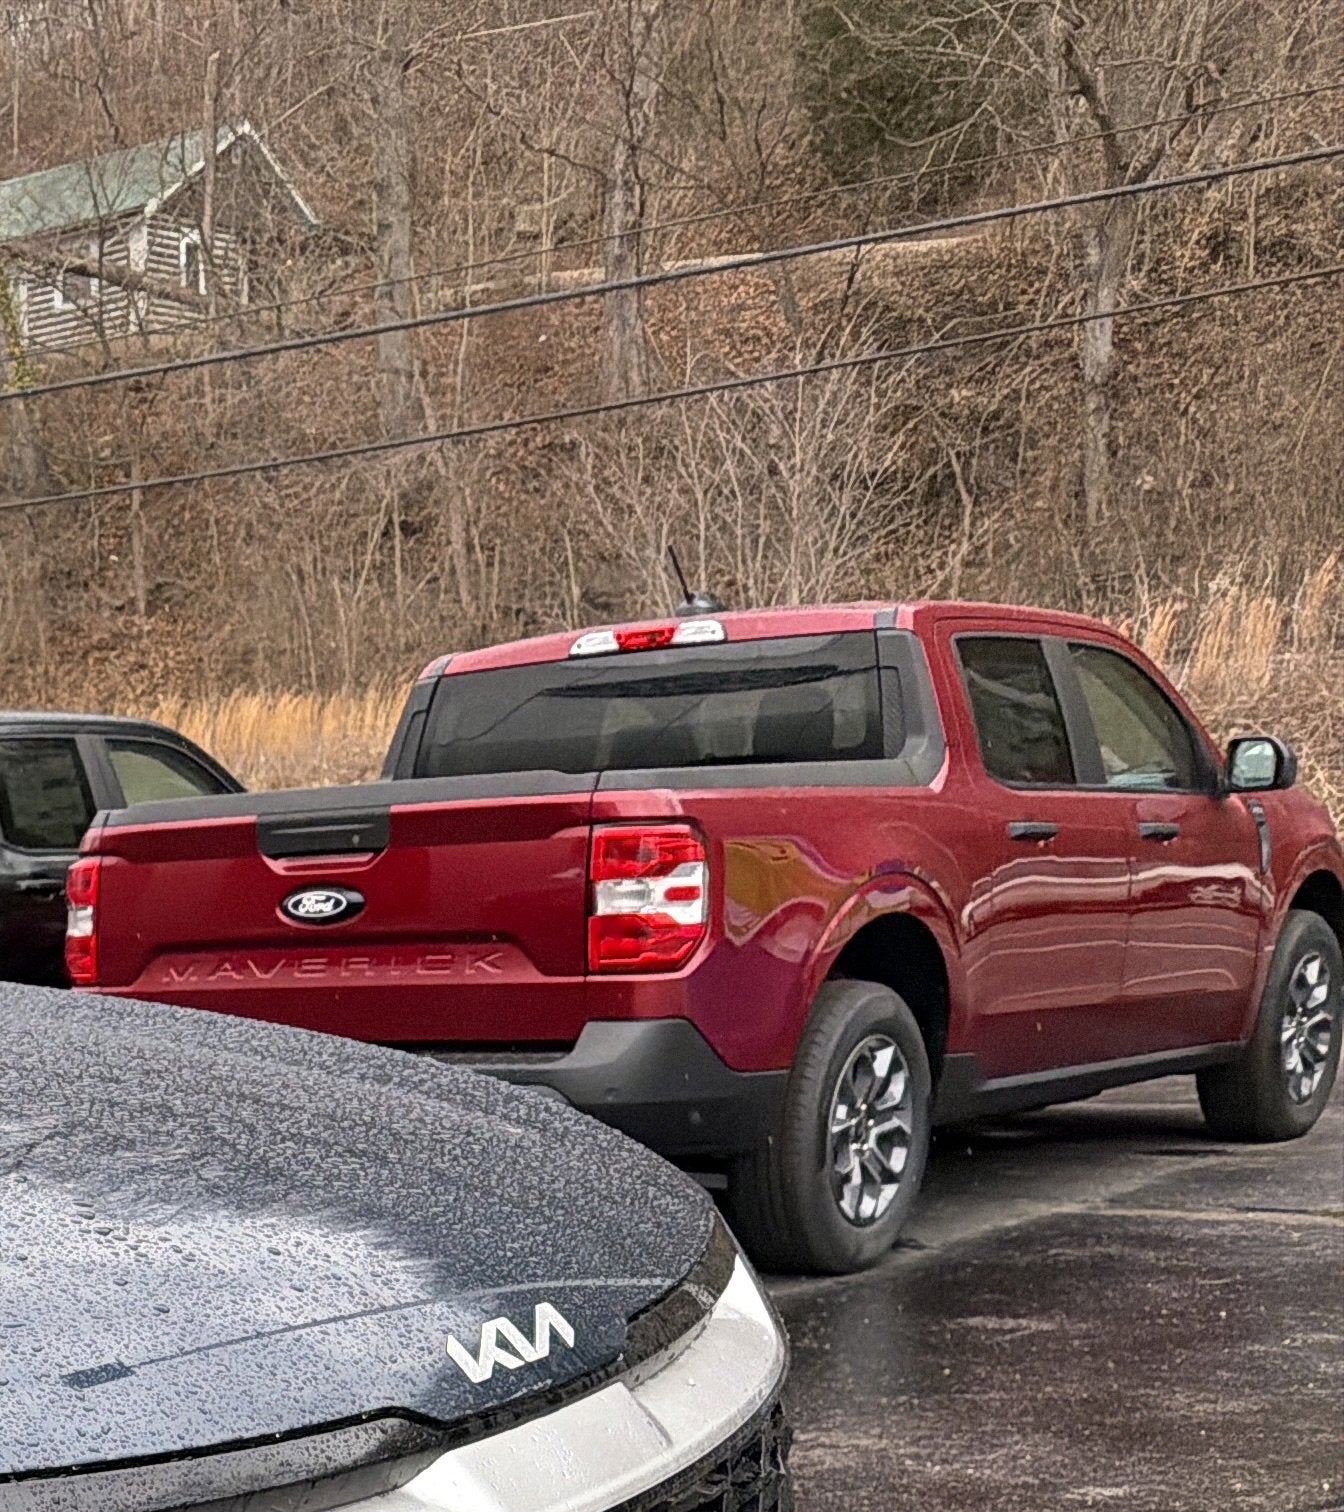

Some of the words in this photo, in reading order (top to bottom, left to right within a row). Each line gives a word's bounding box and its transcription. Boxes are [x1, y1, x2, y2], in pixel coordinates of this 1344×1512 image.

[298, 894, 335, 914] Ford
[162, 952, 504, 983] MAVERICK
[446, 1302, 575, 1384] KIA
